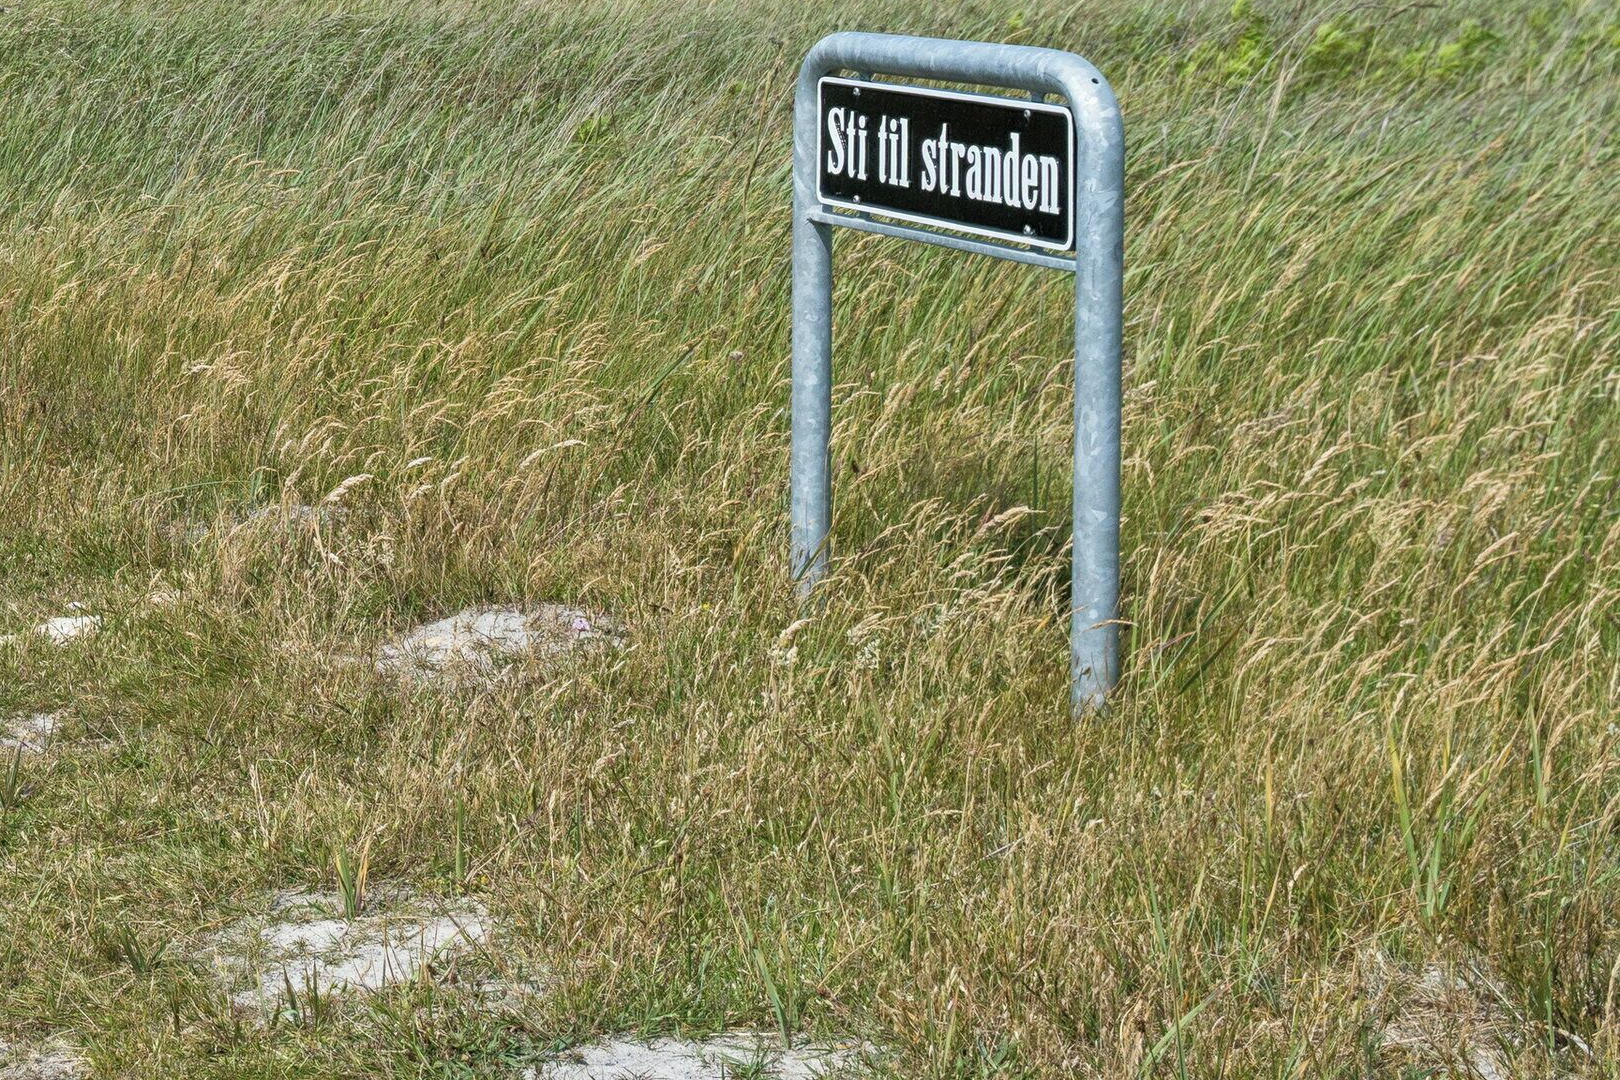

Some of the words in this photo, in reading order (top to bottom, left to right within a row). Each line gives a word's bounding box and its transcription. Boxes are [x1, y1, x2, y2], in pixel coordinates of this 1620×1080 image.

[827, 107, 868, 181] Sti
[878, 115, 911, 188] til
[921, 123, 1060, 215] stranden
